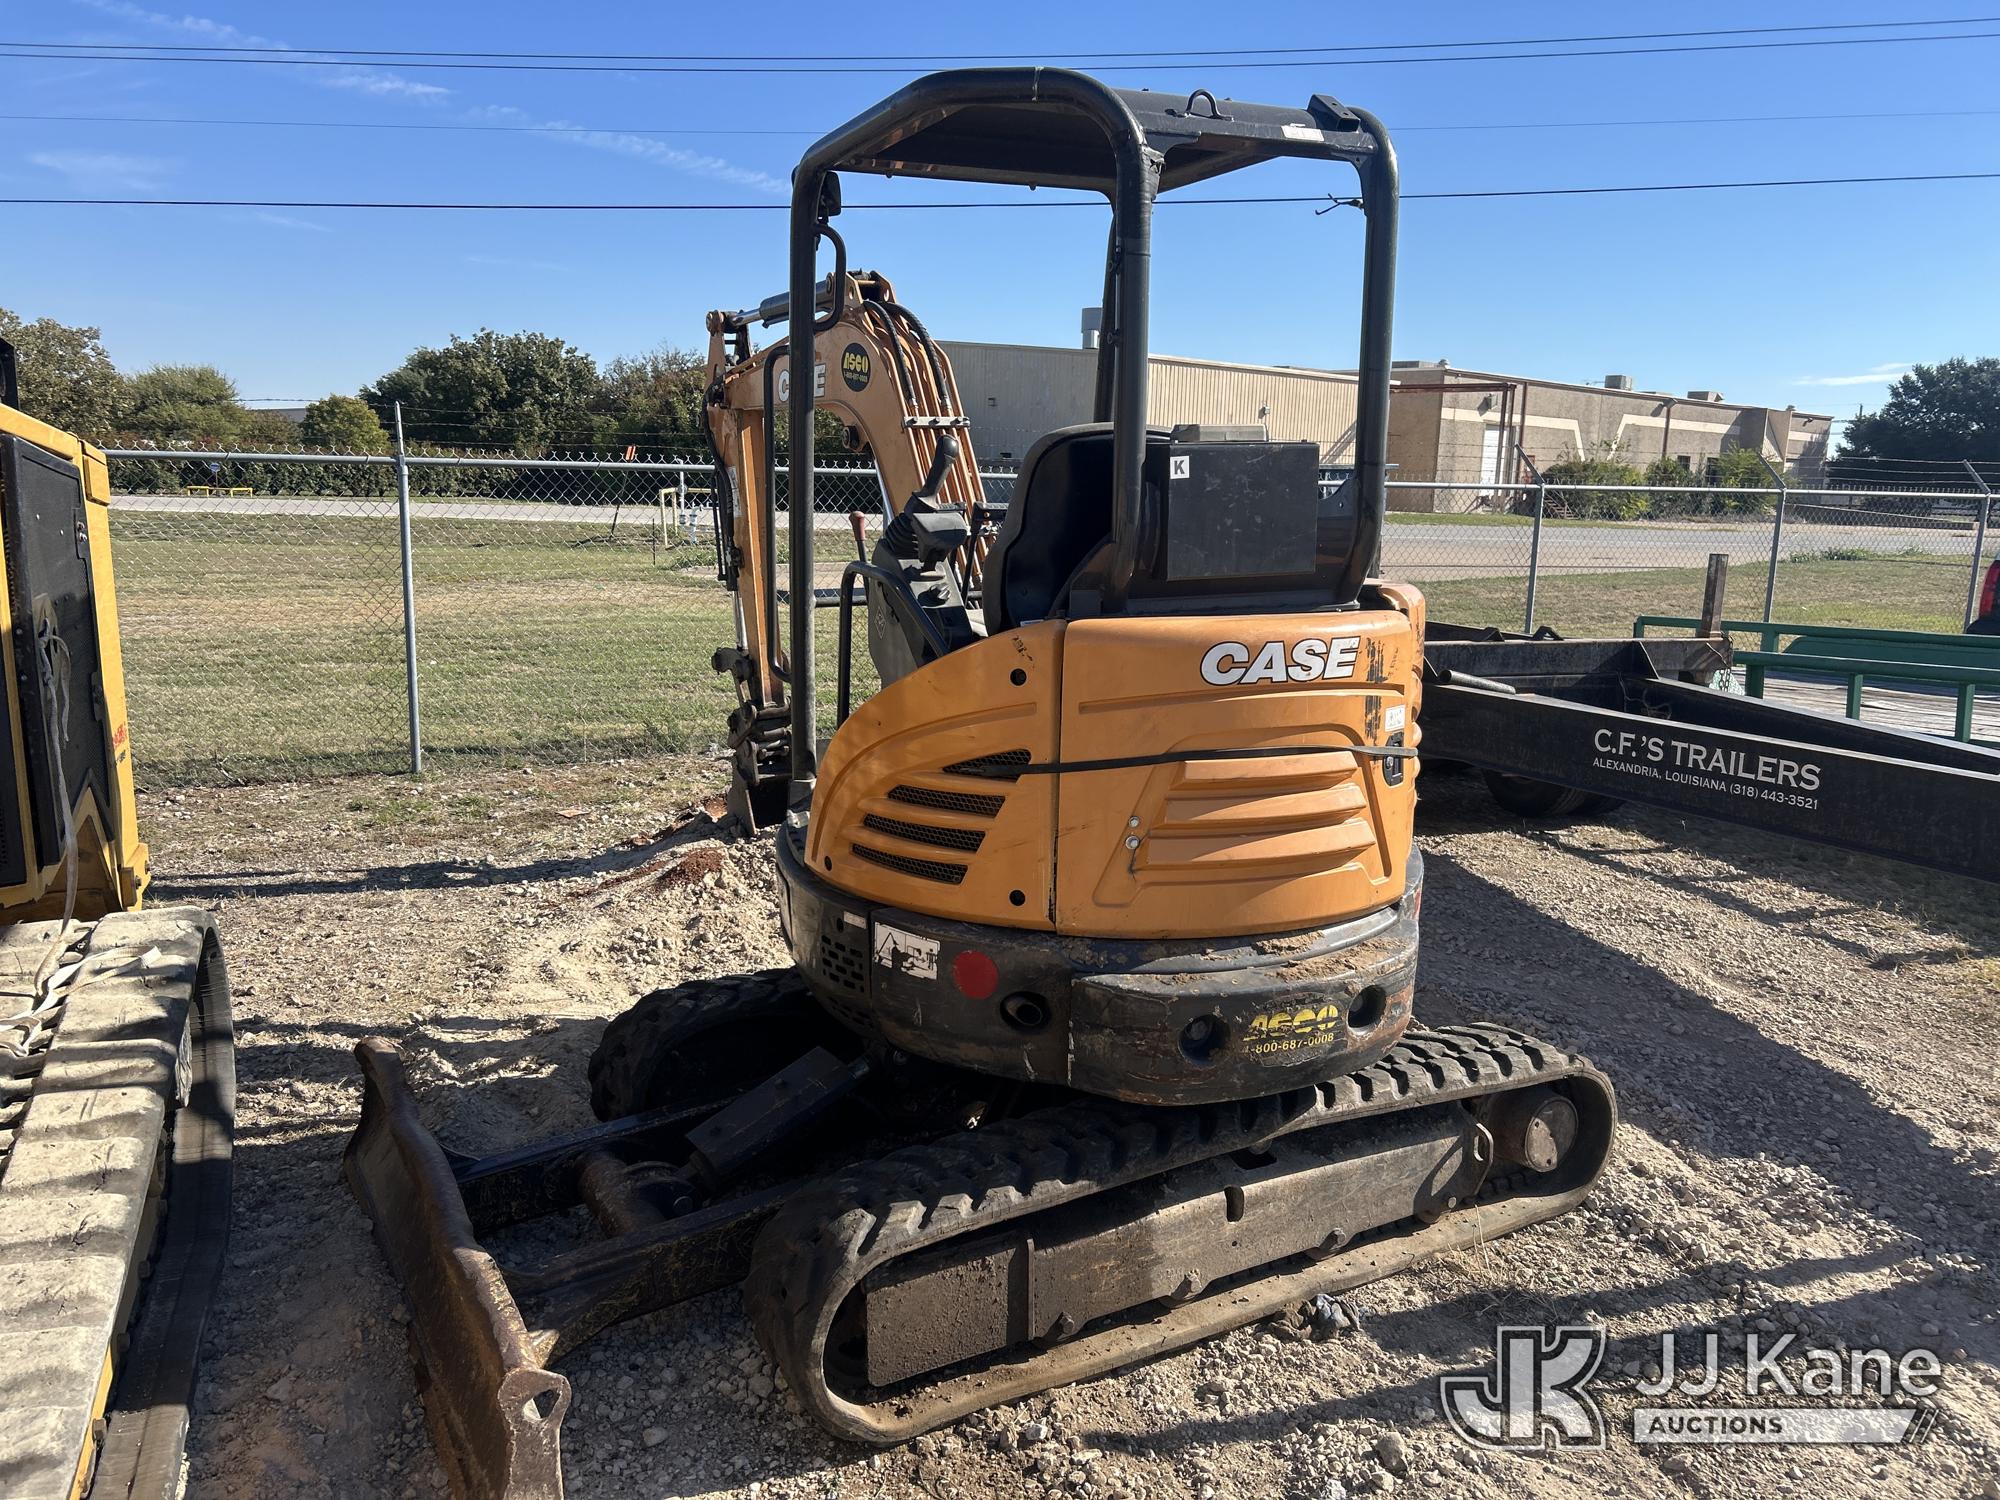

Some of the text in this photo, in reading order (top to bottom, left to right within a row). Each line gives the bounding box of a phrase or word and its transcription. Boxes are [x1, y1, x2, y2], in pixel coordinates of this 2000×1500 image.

[778, 363, 826, 402] CE
[843, 352, 869, 374] ASCO
[1173, 459, 1185, 475] K
[1200, 636, 1361, 686] CASE
[1592, 757, 1819, 810] ALEXANDRIA, LOUISIANA (318) 443-3521
[1670, 740, 1822, 791] TRAILERS
